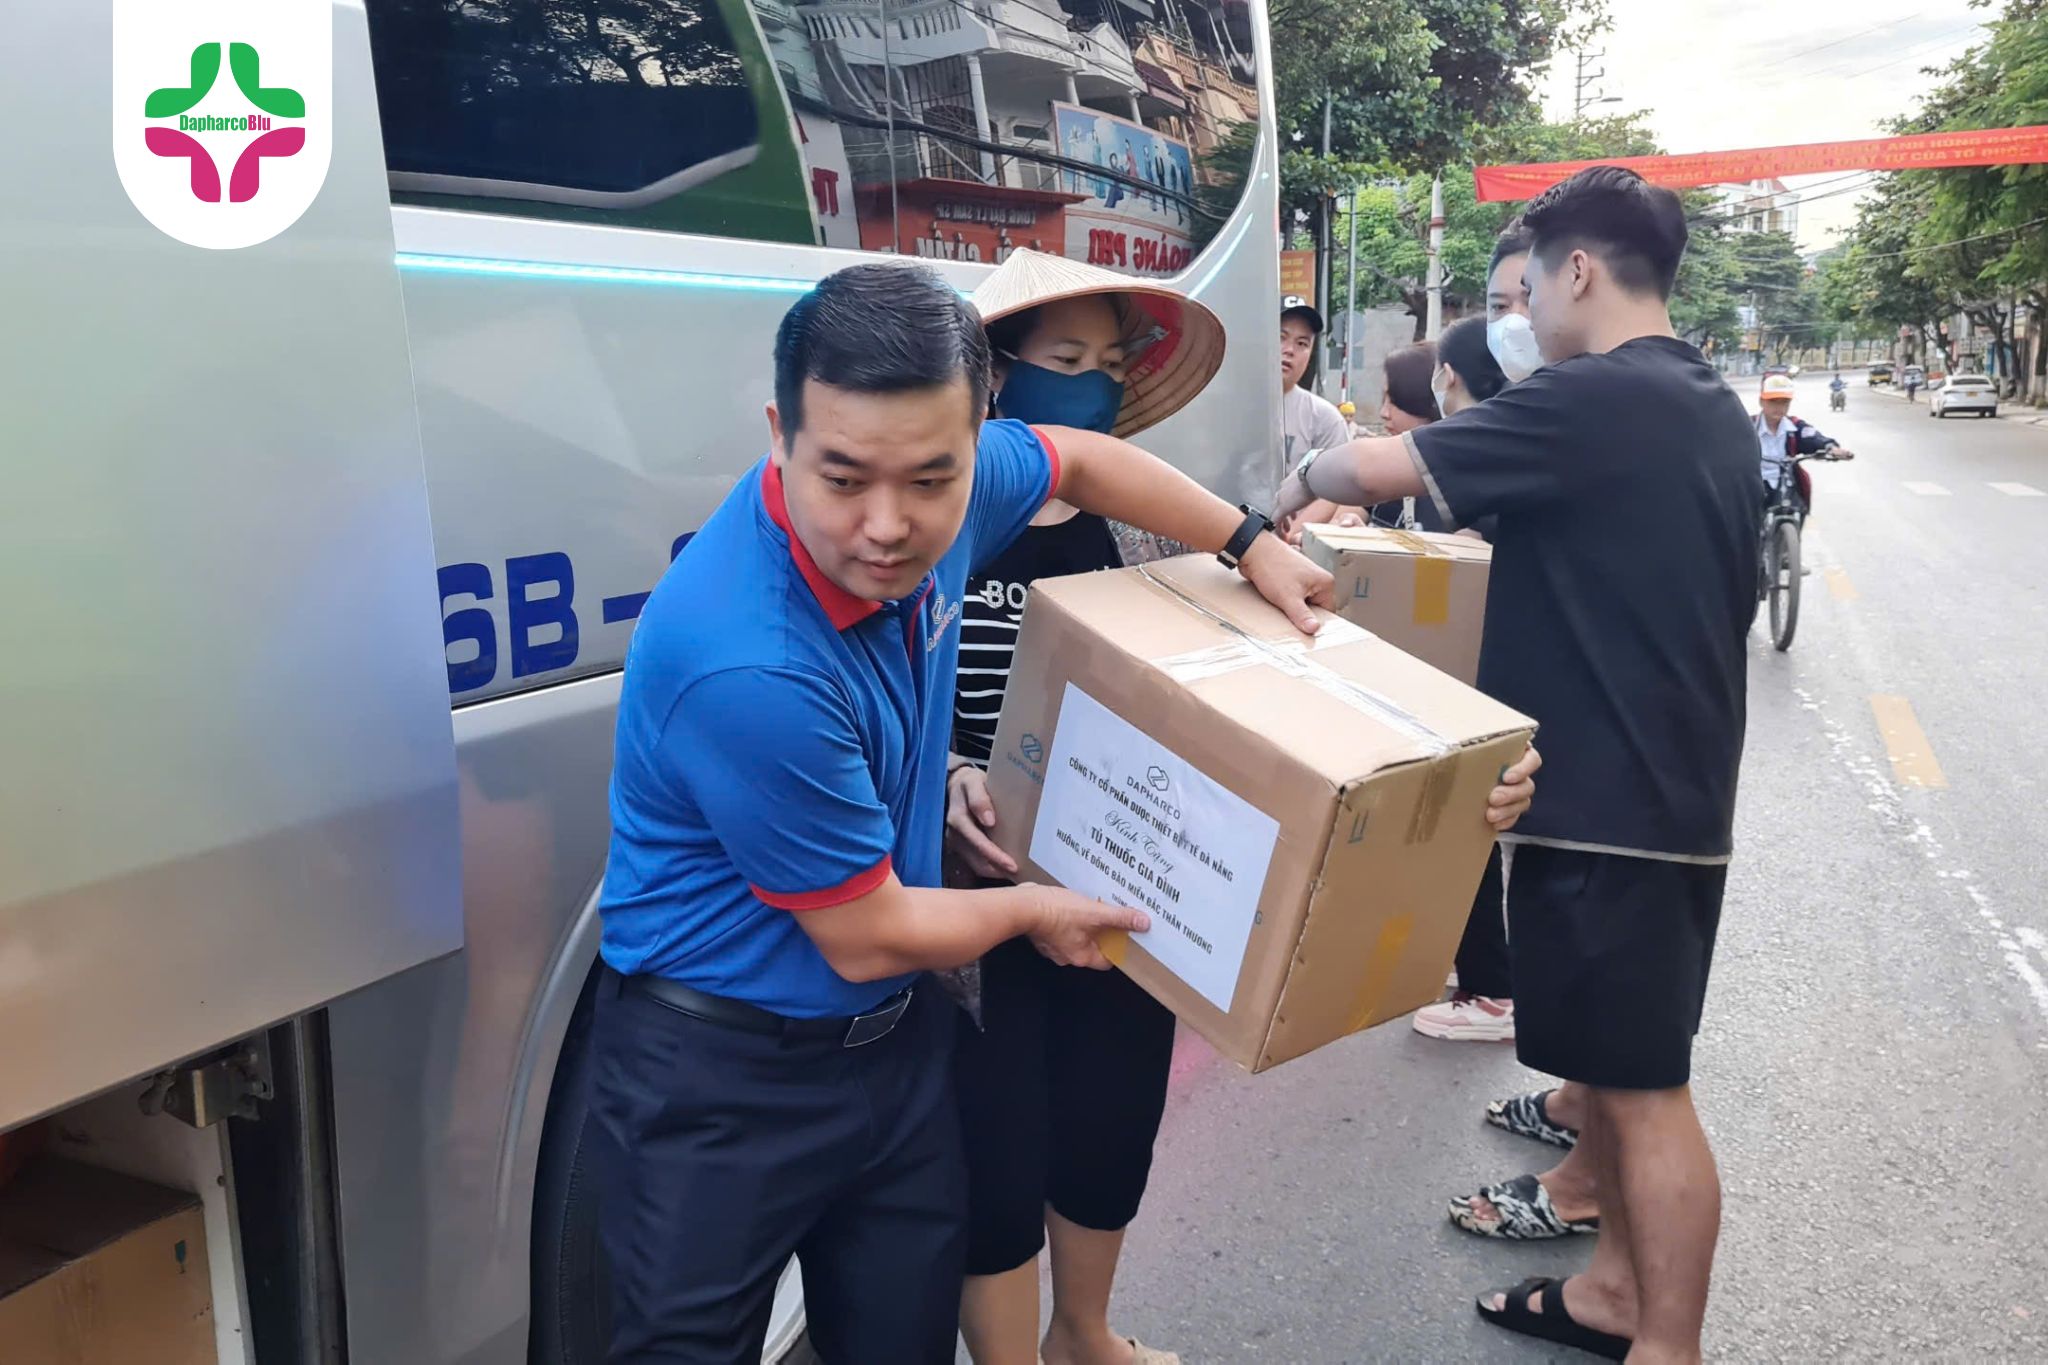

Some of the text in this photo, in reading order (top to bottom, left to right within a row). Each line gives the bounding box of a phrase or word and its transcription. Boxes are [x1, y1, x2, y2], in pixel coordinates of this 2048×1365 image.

[1069, 757, 1088, 777] CÔNG
[1089, 771, 1097, 783] TY
[1127, 776, 1180, 820] DAPHARCO
[1105, 836, 1136, 869] THUỐC
[1138, 862, 1154, 884] GIA
[1156, 875, 1180, 903] ĐÌNH
